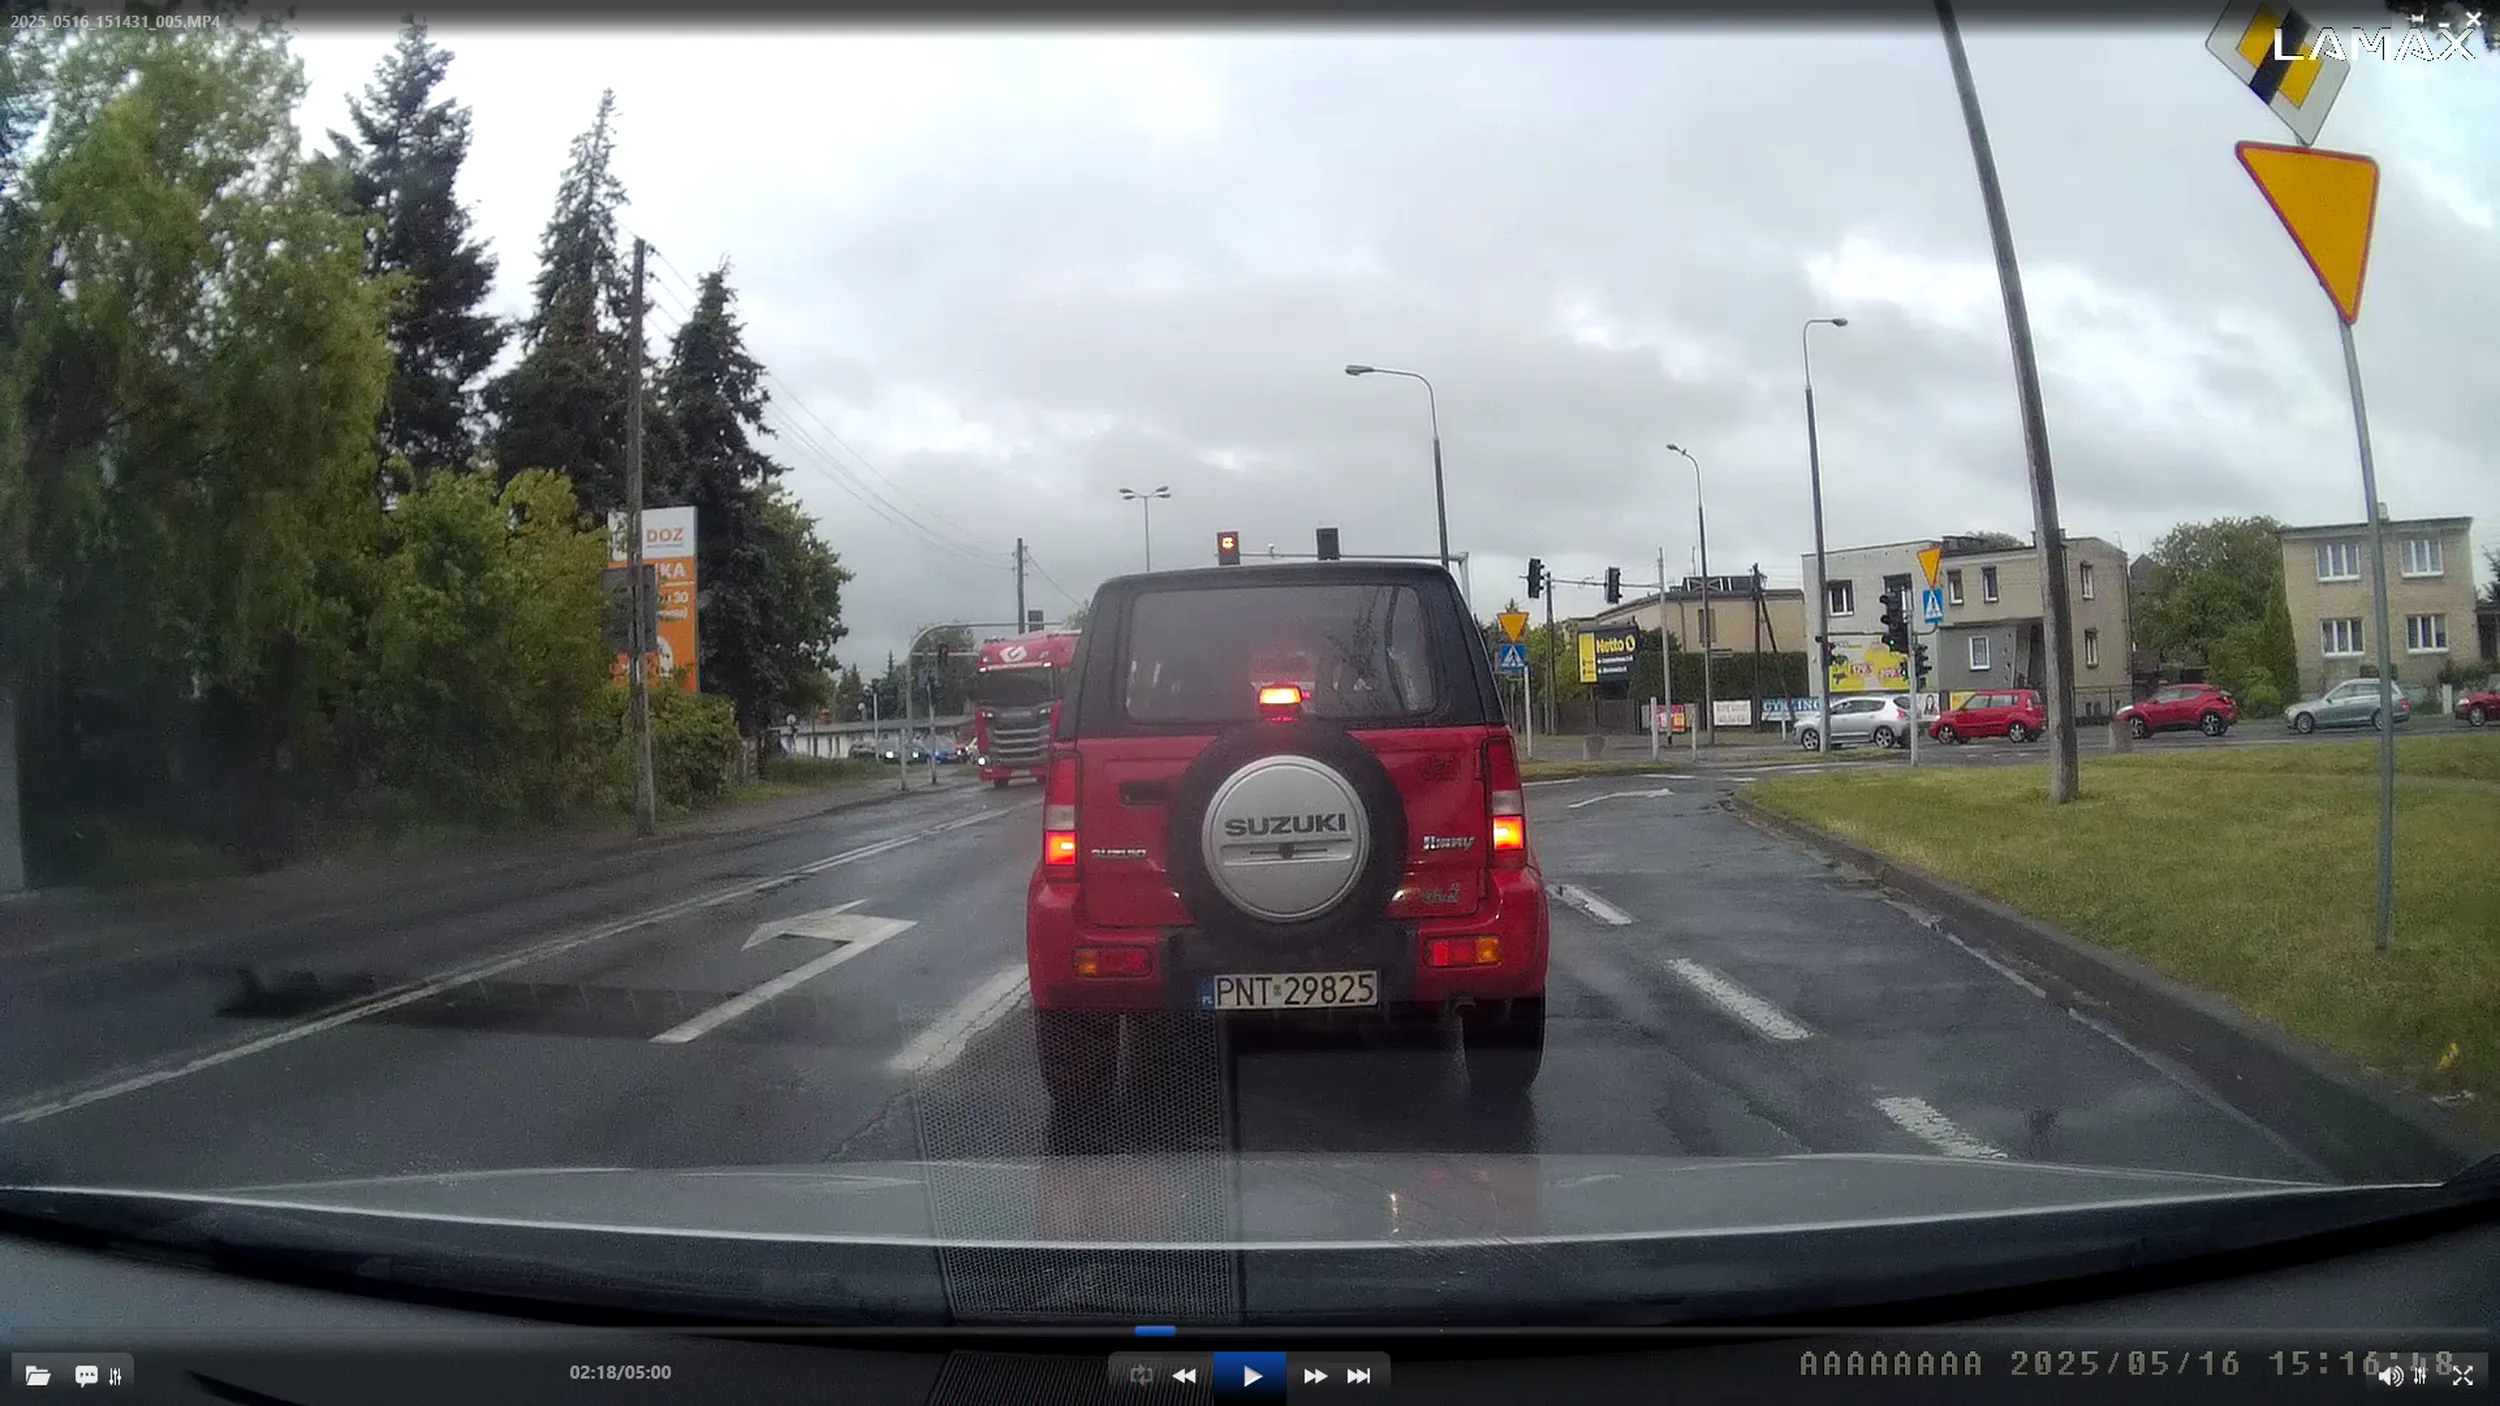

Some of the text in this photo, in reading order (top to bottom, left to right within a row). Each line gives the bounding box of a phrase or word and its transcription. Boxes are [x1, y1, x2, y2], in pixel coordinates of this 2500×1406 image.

[646, 528, 685, 542] DOZ
[1225, 813, 1347, 836] SUZUKI
[1216, 977, 1273, 1007] PNT
[1283, 973, 1375, 1006] 29825
